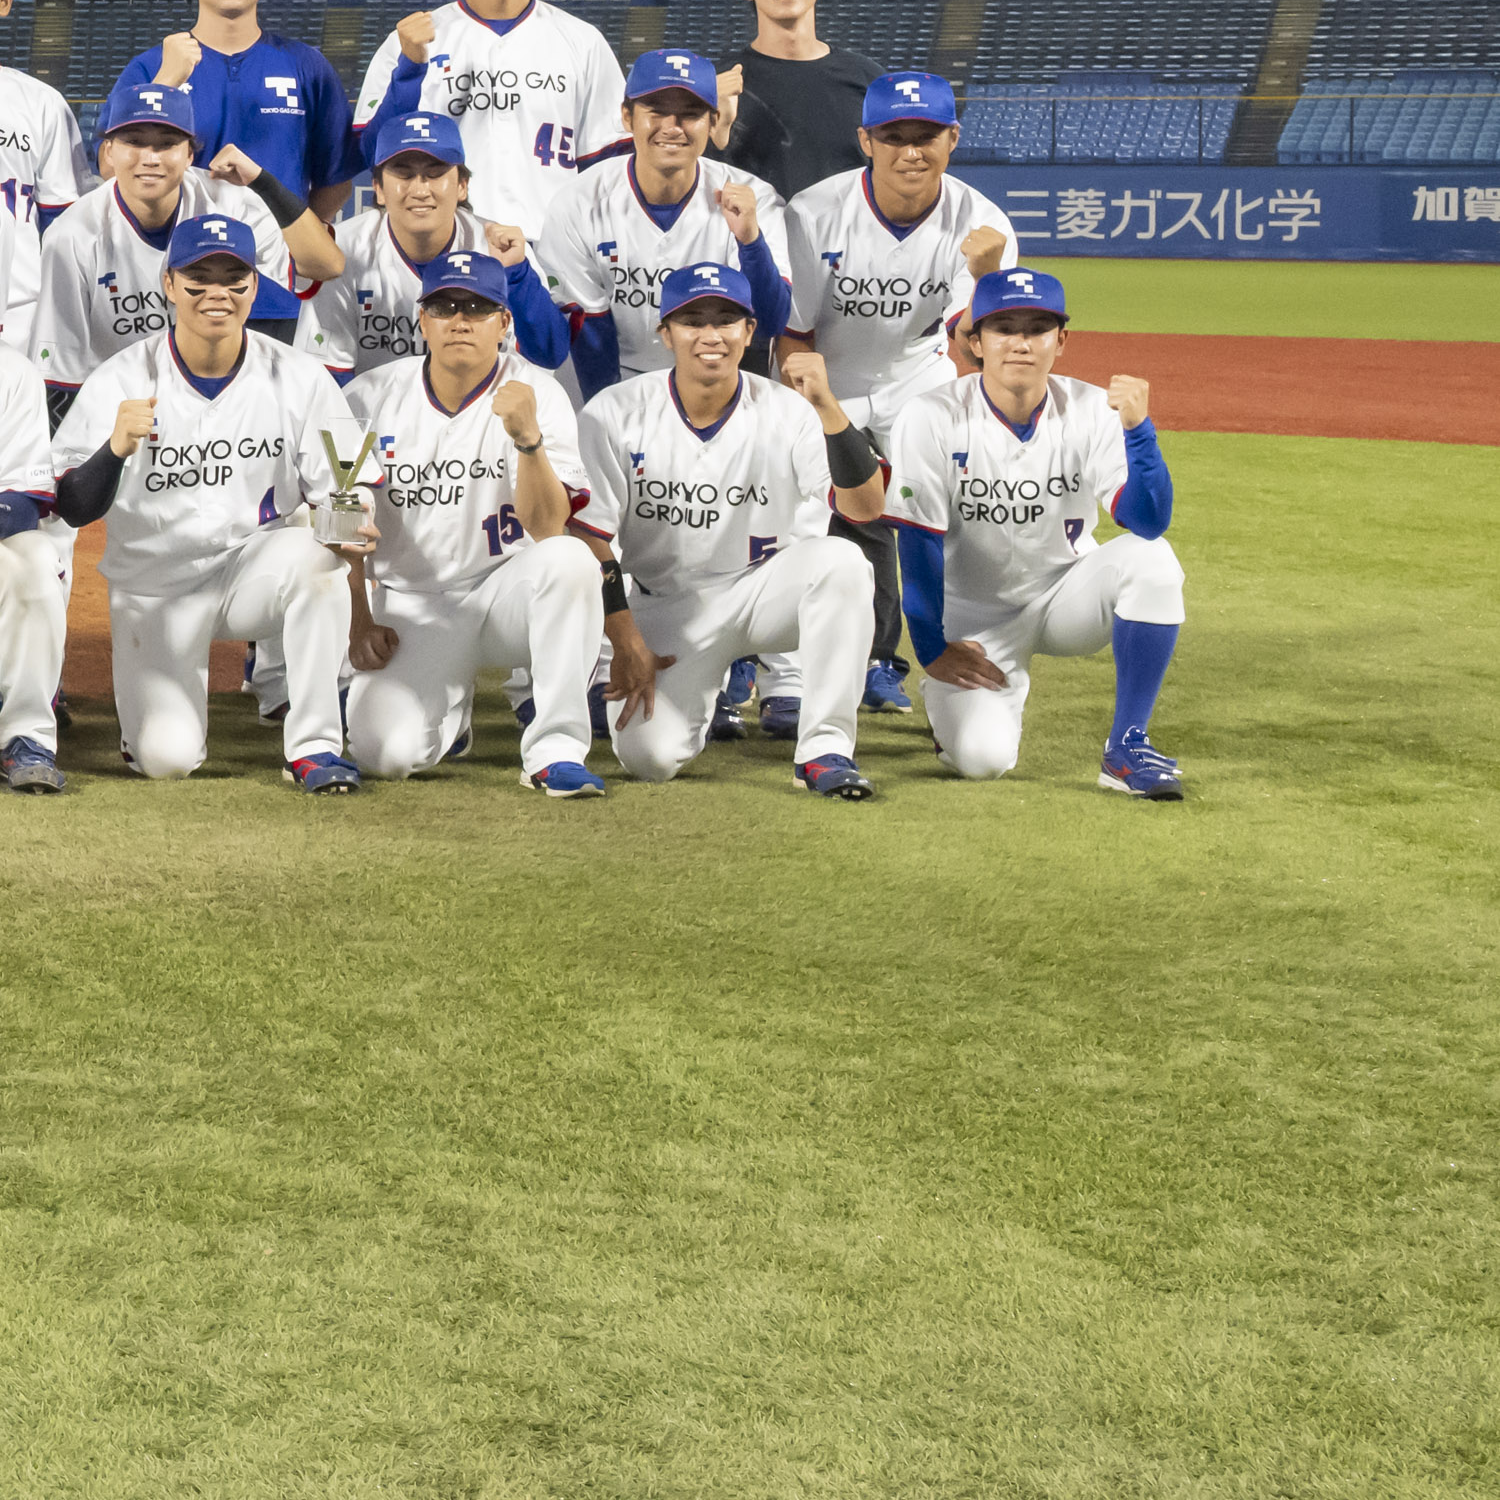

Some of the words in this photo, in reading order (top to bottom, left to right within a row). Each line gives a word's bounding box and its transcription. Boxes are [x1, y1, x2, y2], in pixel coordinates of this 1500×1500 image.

[443, 70, 518, 94] TOKYO
[525, 73, 566, 94] GAS
[447, 92, 521, 116] GROUP
[1006, 188, 1321, 243] 三菱ガス化学
[148, 440, 233, 466] TOKYO
[237, 438, 284, 460] GAS
[145, 466, 234, 493] GROUP
[384, 459, 463, 486] TOKYO
[469, 457, 505, 480] GAS
[388, 484, 464, 509] GROUP
[634, 479, 718, 505] TOKYO
[727, 485, 768, 506] GAS
[960, 479, 1040, 502] TOKYO
[635, 502, 719, 530] GROUP
[958, 503, 1044, 525] GROUP
